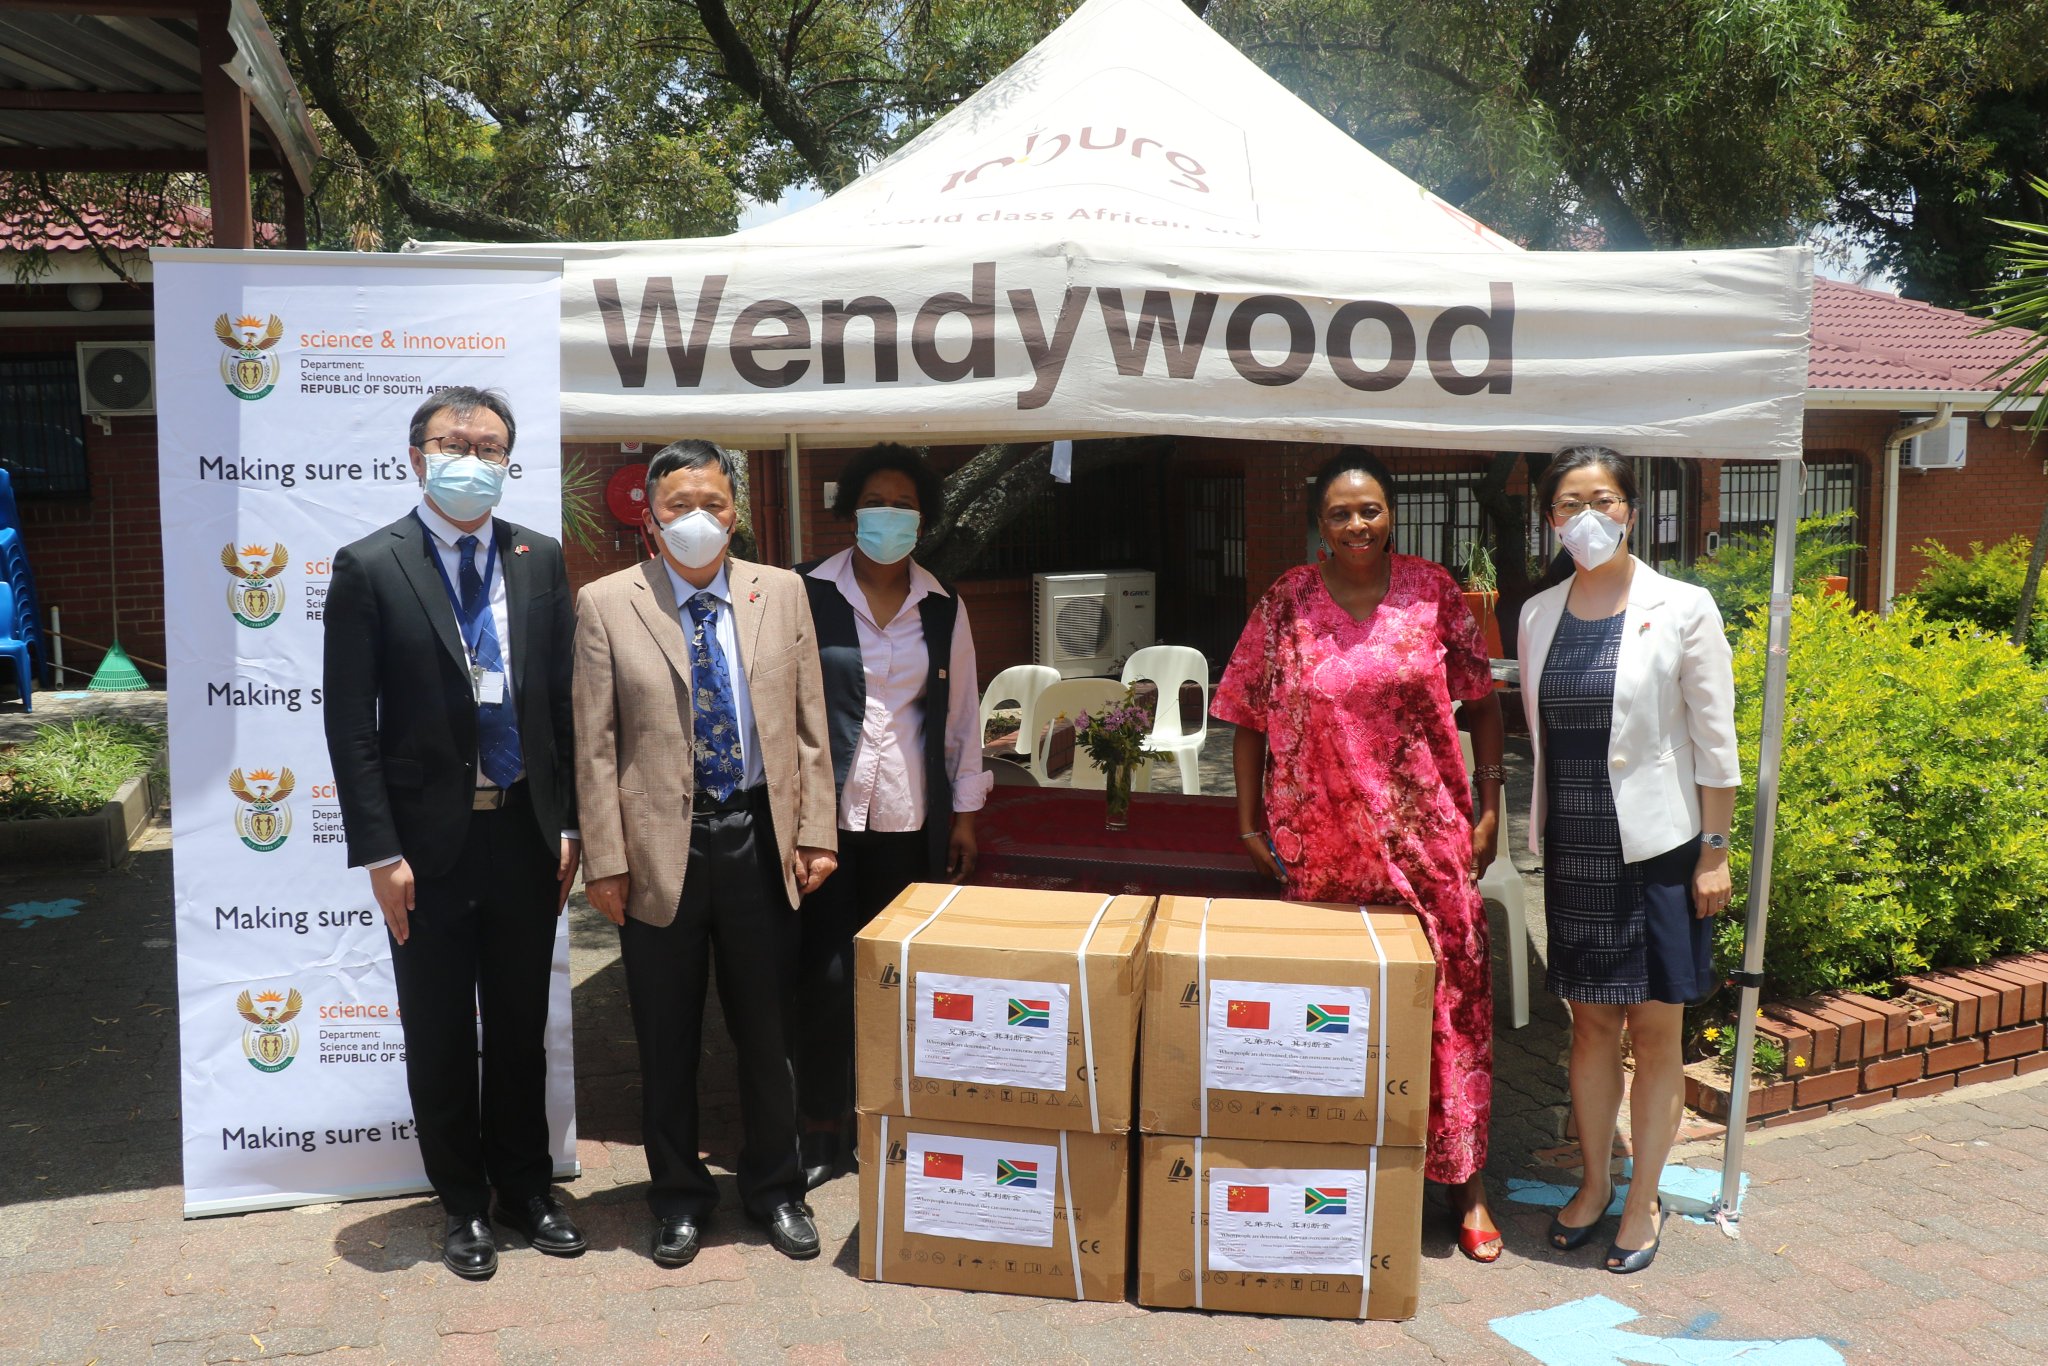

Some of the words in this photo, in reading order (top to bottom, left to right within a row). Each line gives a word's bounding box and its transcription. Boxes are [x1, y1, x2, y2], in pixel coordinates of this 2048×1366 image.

[976, 210, 1054, 222] class
[300, 330, 374, 349] science
[381, 330, 396, 349] &
[403, 332, 506, 350] innovation
[593, 262, 1516, 410] Wendywood
[300, 359, 365, 371] Department:
[301, 372, 341, 382] Science
[344, 372, 363, 382] and
[367, 373, 422, 383] Innovation
[301, 384, 361, 394] REPUBLIC
[364, 385, 380, 394] OF
[383, 385, 424, 395] SOUTH
[199, 456, 296, 488] Making
[305, 463, 363, 480] sure
[373, 456, 408, 481] it's
[207, 682, 302, 713] Making
[313, 822, 346, 831] Scienc
[215, 905, 309, 934] Making
[318, 910, 373, 927] sure
[319, 1001, 389, 1019] science
[320, 1030, 381, 1041] Department:
[320, 1042, 358, 1051] Science
[361, 1042, 379, 1051] and
[320, 1053, 377, 1063] REPUBLIC
[380, 1053, 396, 1062] OF
[222, 1125, 317, 1152] Making
[325, 1127, 381, 1145] sure
[1054, 1211, 1081, 1221] Mak
